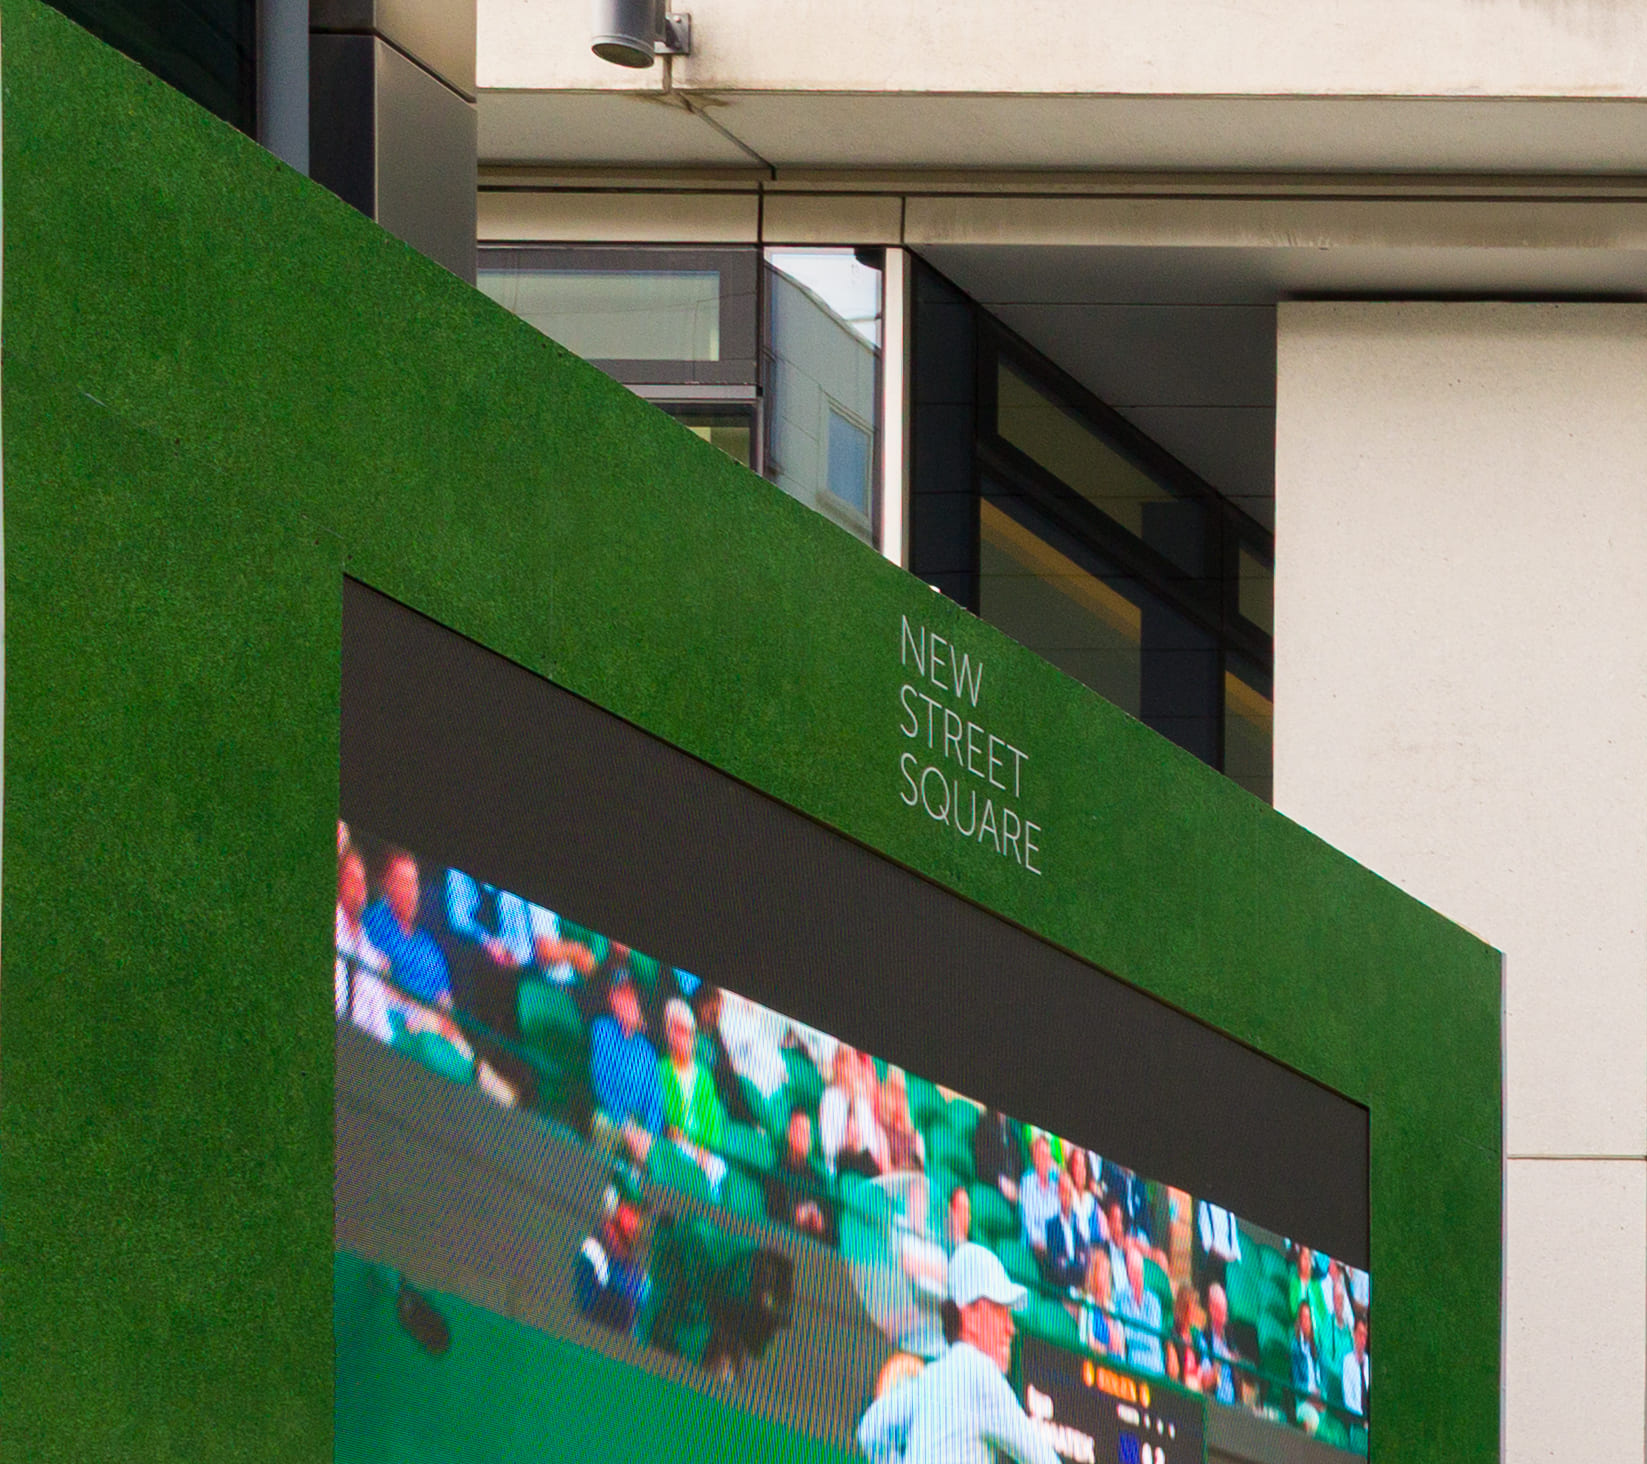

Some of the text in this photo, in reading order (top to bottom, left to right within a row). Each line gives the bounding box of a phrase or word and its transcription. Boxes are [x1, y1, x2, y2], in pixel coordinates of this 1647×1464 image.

[902, 614, 983, 707] NEW
[900, 684, 1029, 798] STREET
[900, 752, 1042, 875] SQUARE
